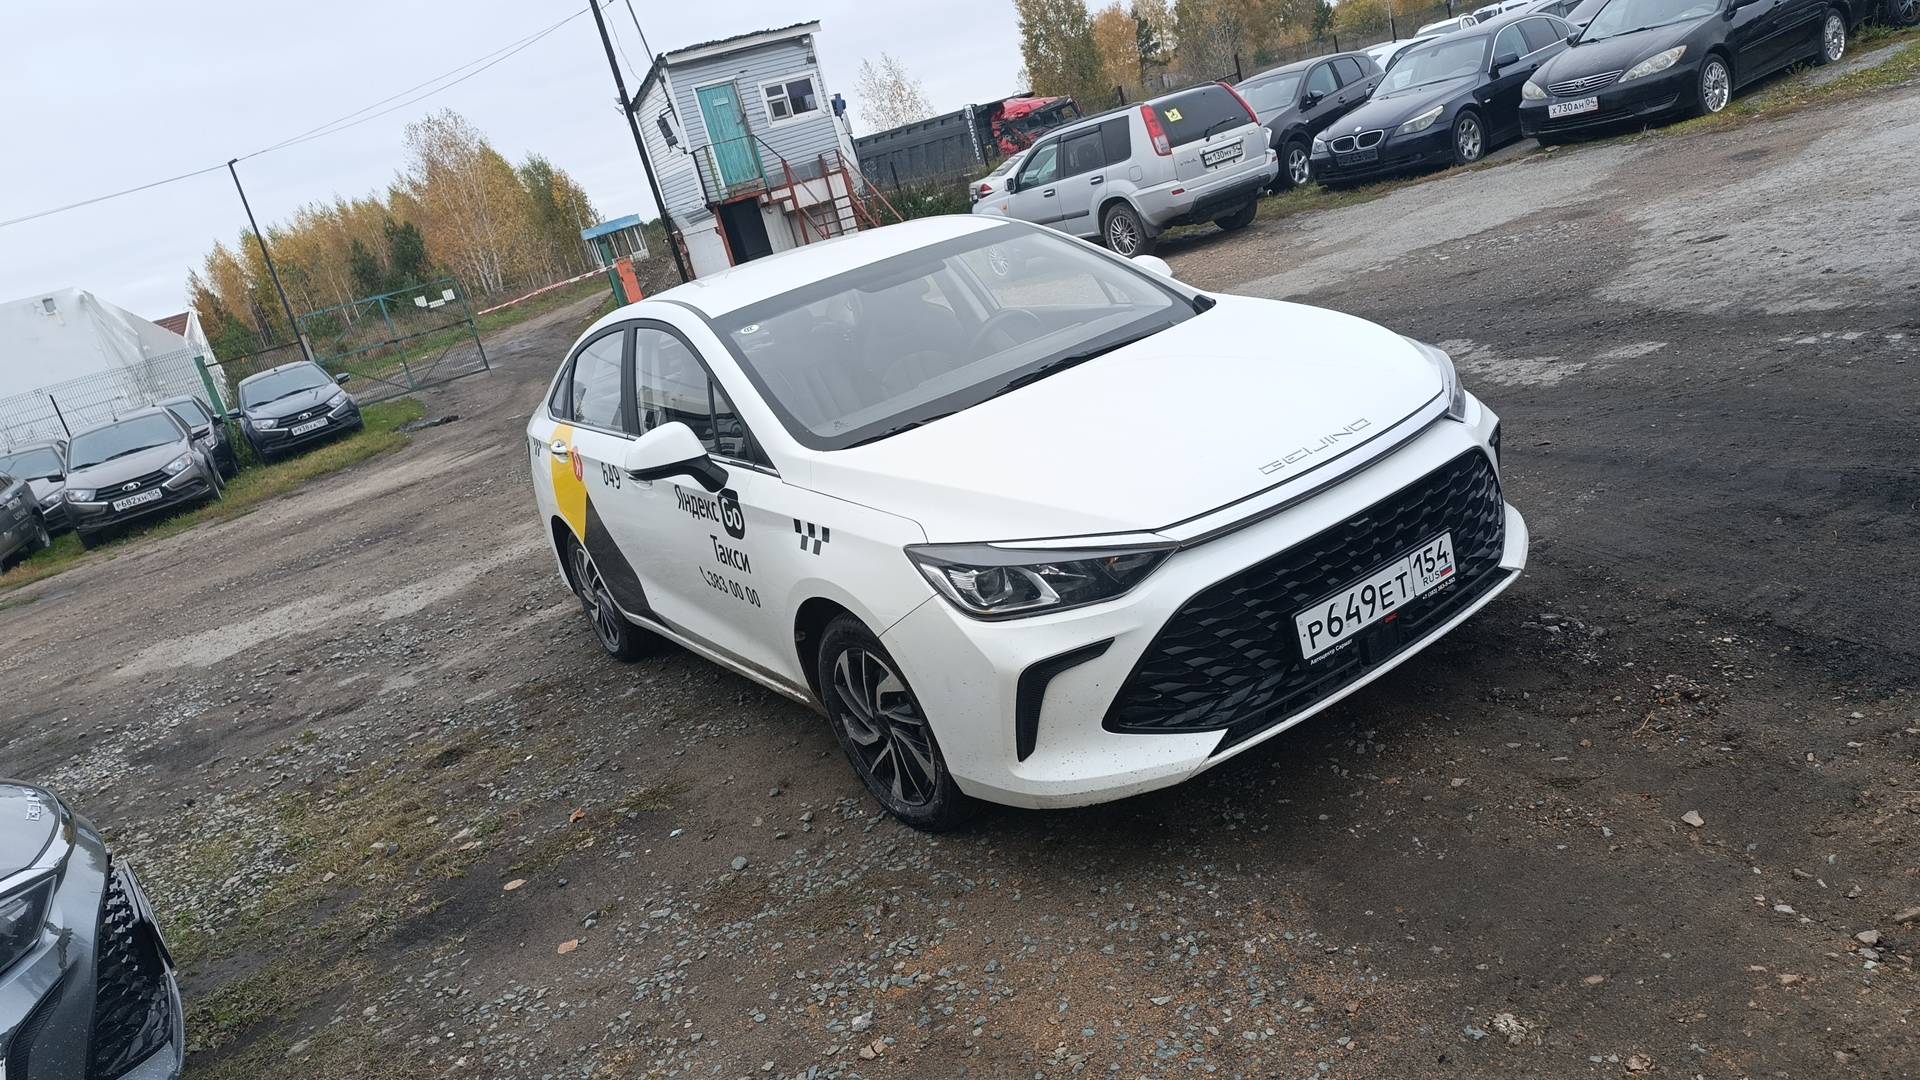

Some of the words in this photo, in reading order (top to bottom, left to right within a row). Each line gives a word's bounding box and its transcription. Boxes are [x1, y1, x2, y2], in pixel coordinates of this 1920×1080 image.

[601, 461, 621, 490] 649
[674, 484, 719, 522] Яндекс
[721, 498, 743, 530] Go
[710, 534, 752, 574] Такси
[707, 570, 728, 594] 383
[729, 579, 744, 601] 00
[745, 586, 761, 609] 00
[1307, 571, 1408, 649] Р649ЕТ
[1413, 541, 1449, 578] 154
[1423, 570, 1440, 586] RUS
